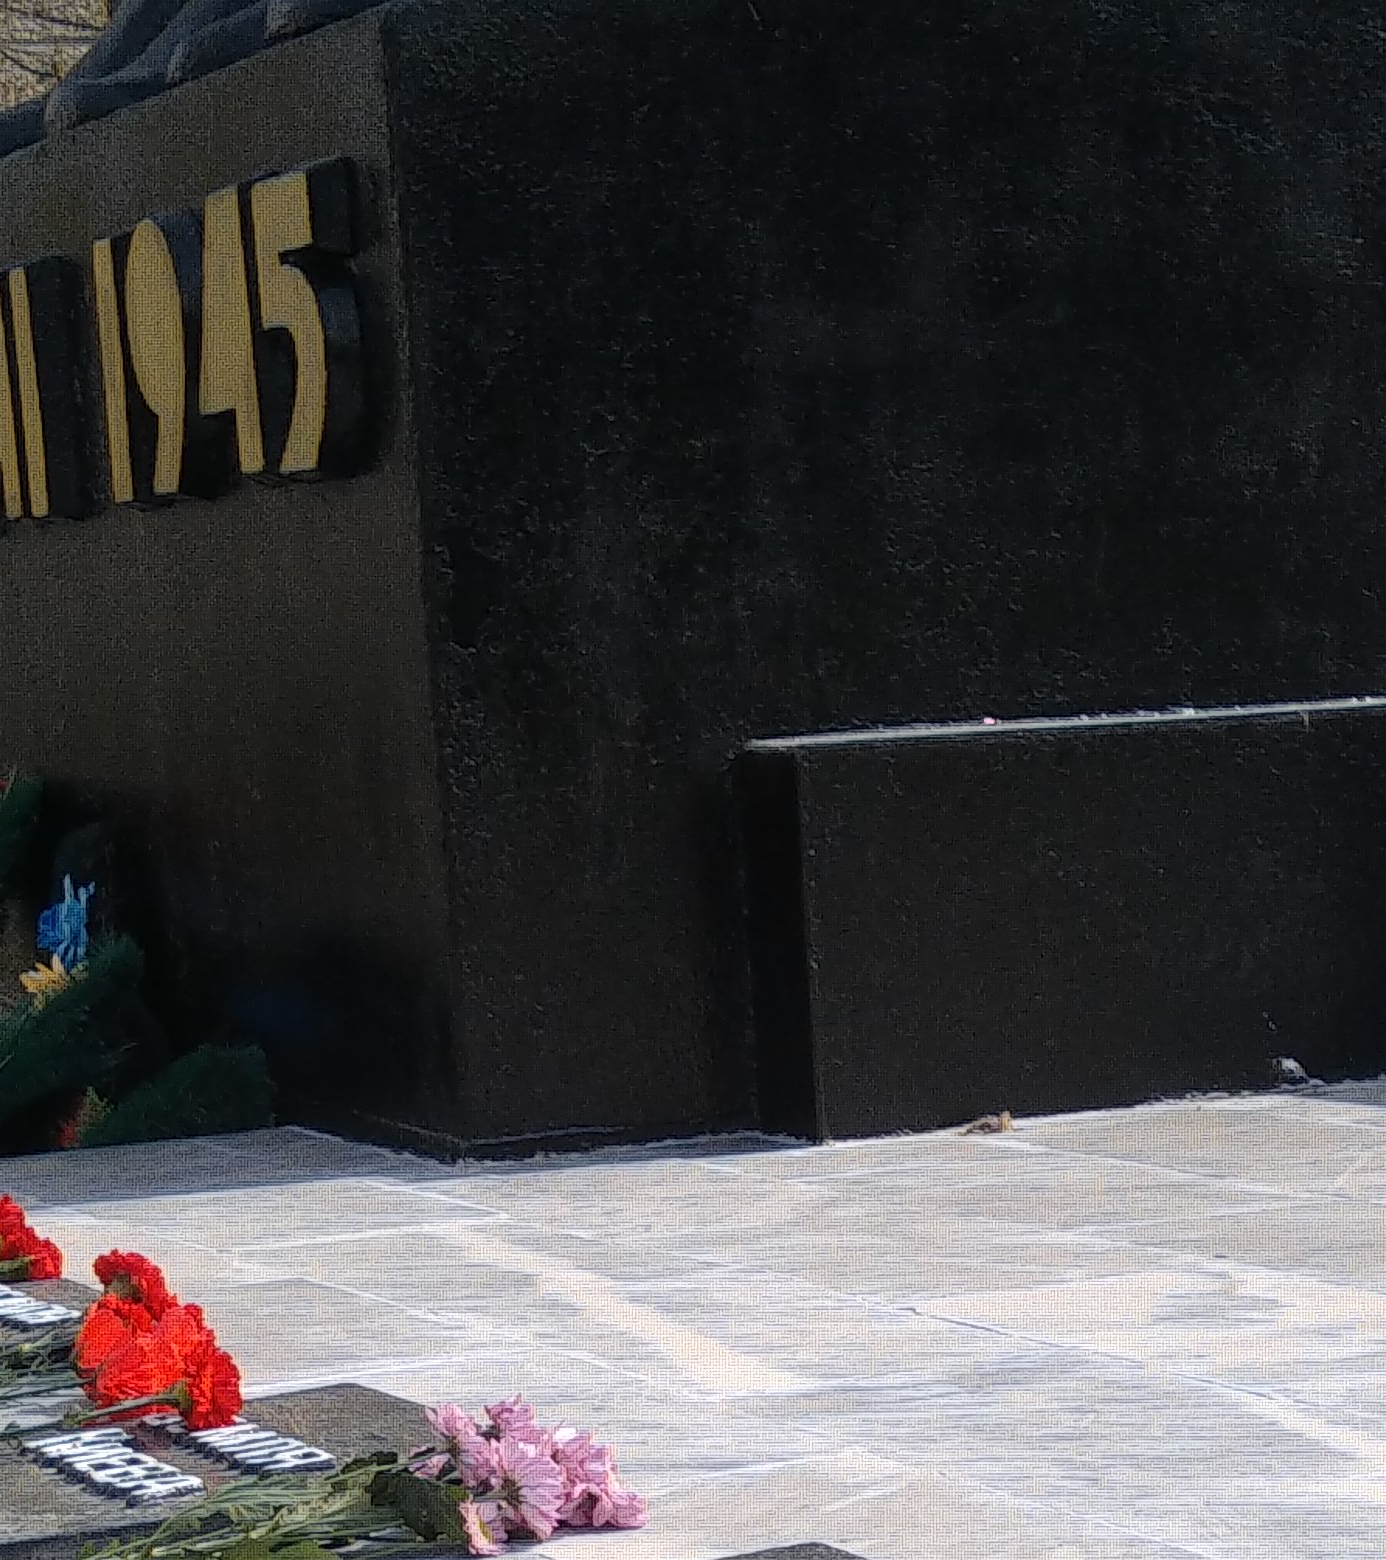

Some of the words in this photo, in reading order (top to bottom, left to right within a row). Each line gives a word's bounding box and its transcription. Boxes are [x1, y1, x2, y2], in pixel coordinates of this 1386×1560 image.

[92, 172, 330, 504] 1945
[23, 1428, 206, 1498] КИЕВА
[140, 1414, 336, 1470] МЛЯ
